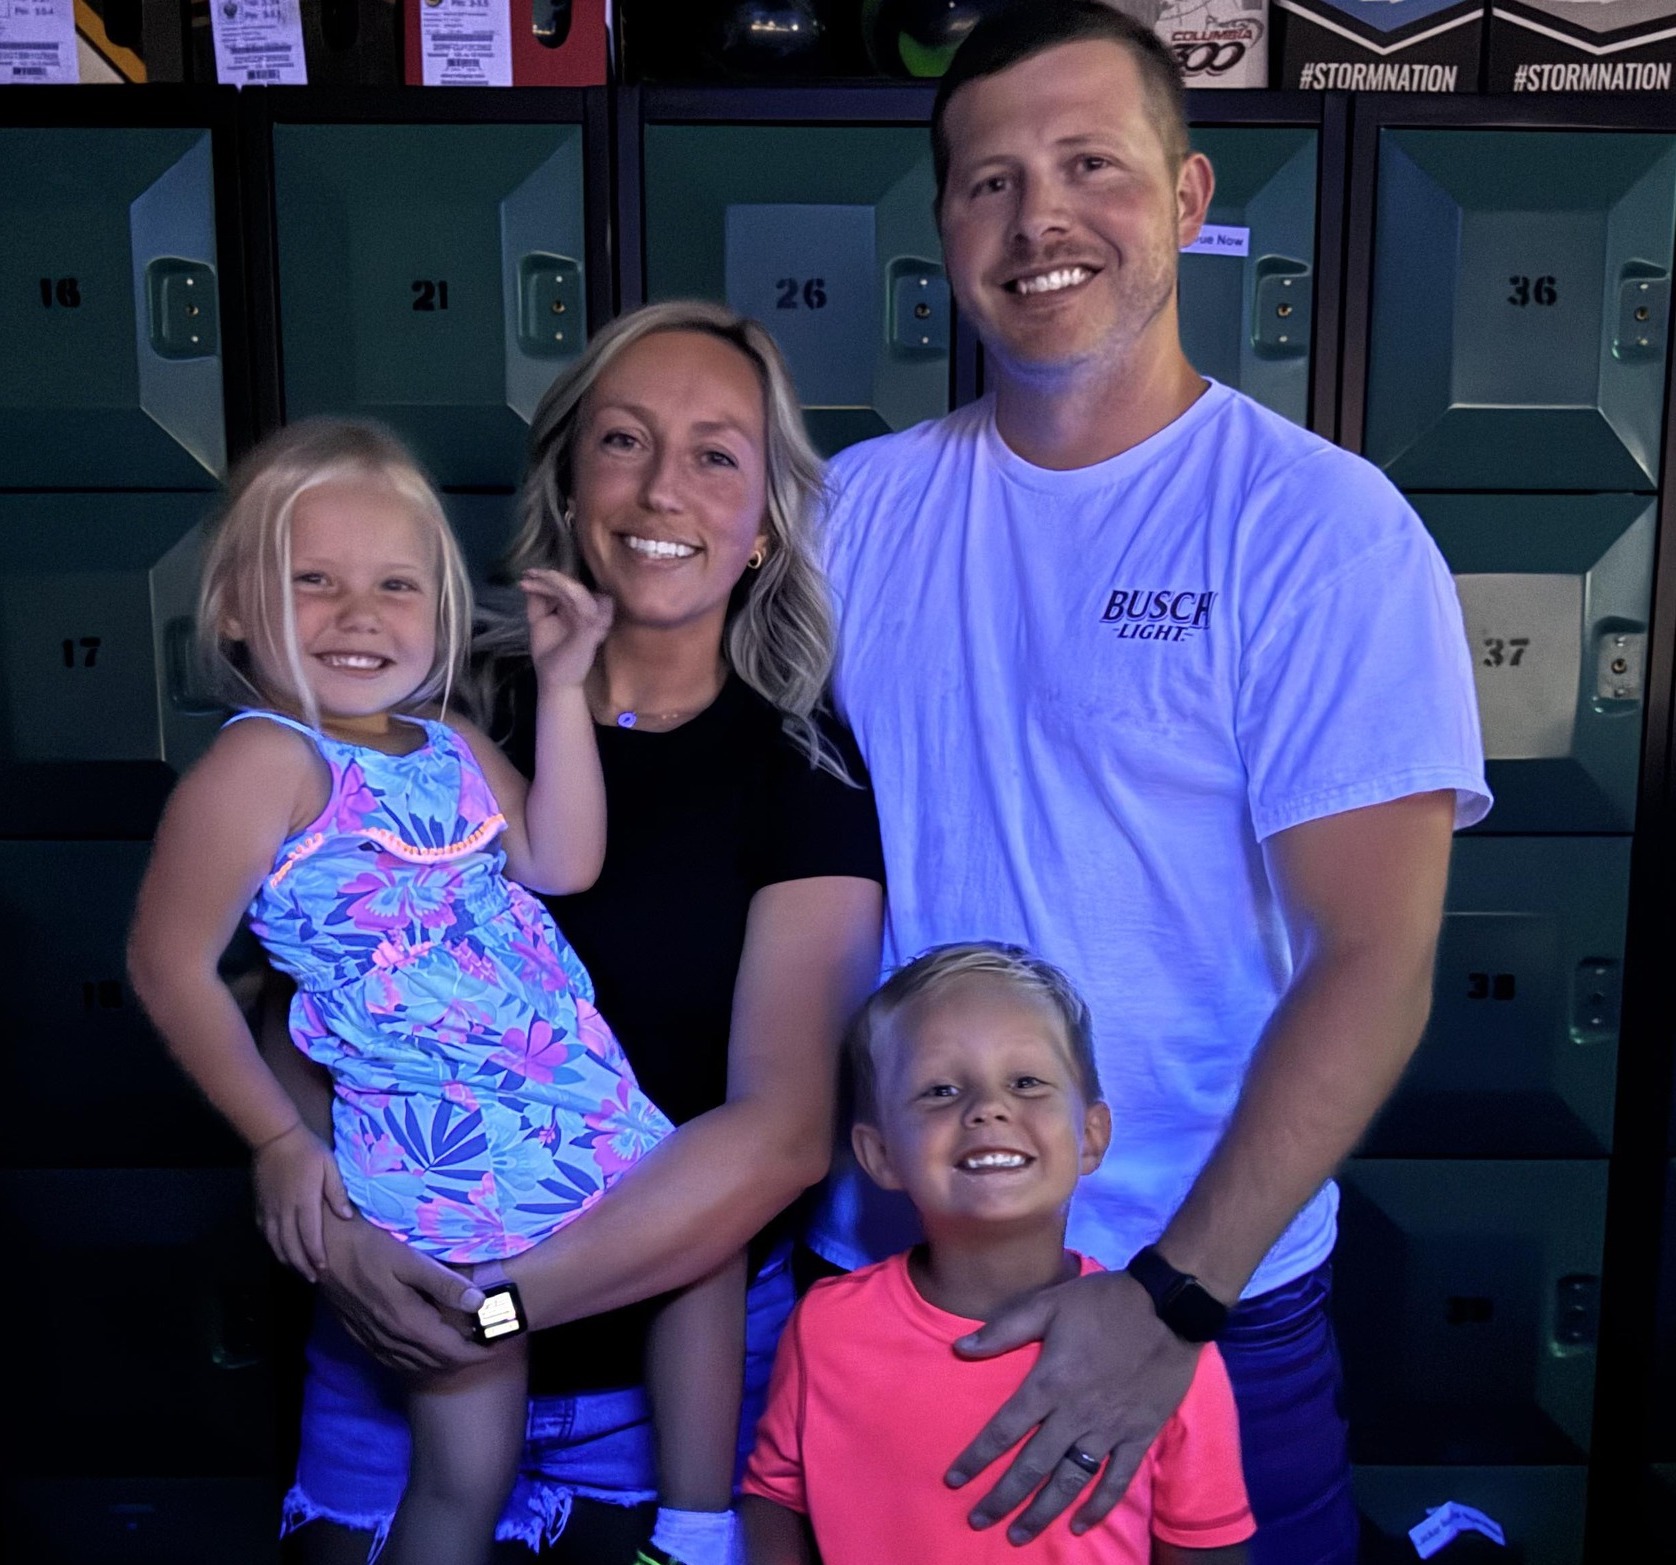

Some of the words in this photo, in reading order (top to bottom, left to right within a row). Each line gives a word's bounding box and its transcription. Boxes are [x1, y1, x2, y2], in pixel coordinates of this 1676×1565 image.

[1172, 29, 1252, 41] COLUMBIA
[1300, 63, 1458, 92] #STORMNATION
[1514, 63, 1672, 92] #STORMNATION
[1217, 234, 1244, 246] Now
[40, 277, 81, 309] 16
[411, 280, 449, 312] 21
[775, 277, 827, 310] 26
[1507, 275, 1557, 308] 36
[1100, 589, 1217, 629] BUSCH
[62, 636, 101, 668] 17
[1483, 638, 1530, 667] 37
